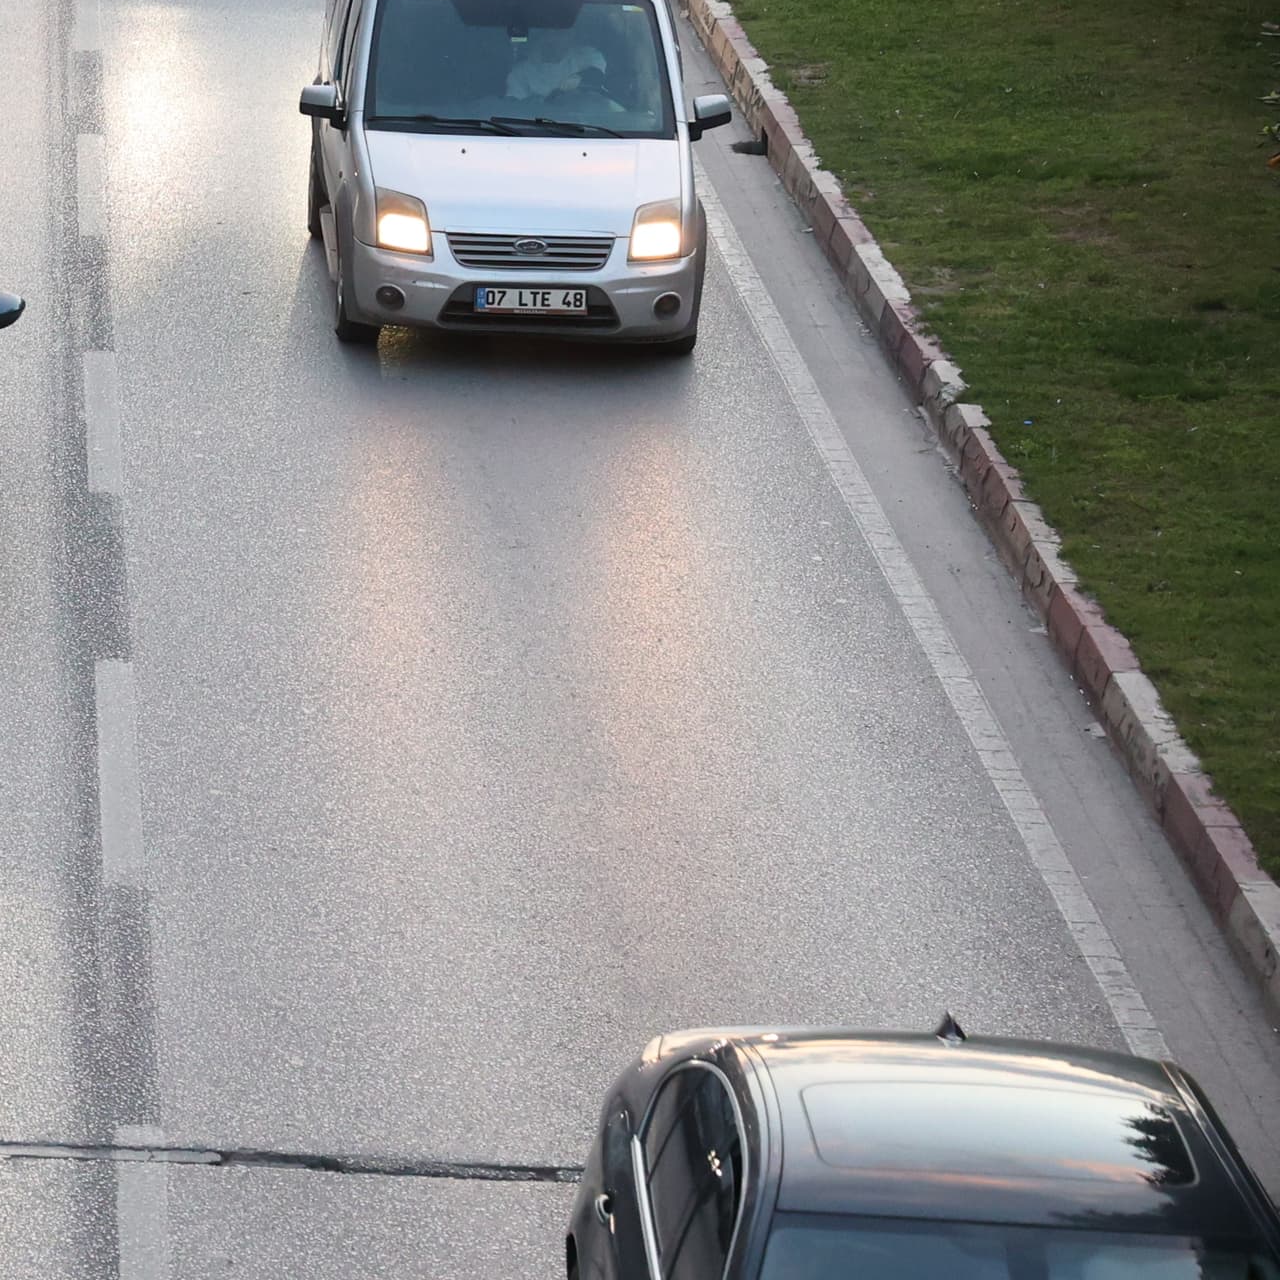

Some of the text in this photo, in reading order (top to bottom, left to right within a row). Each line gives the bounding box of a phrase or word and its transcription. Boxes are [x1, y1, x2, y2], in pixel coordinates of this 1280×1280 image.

[486, 290, 584, 308] 07 LTE 48
